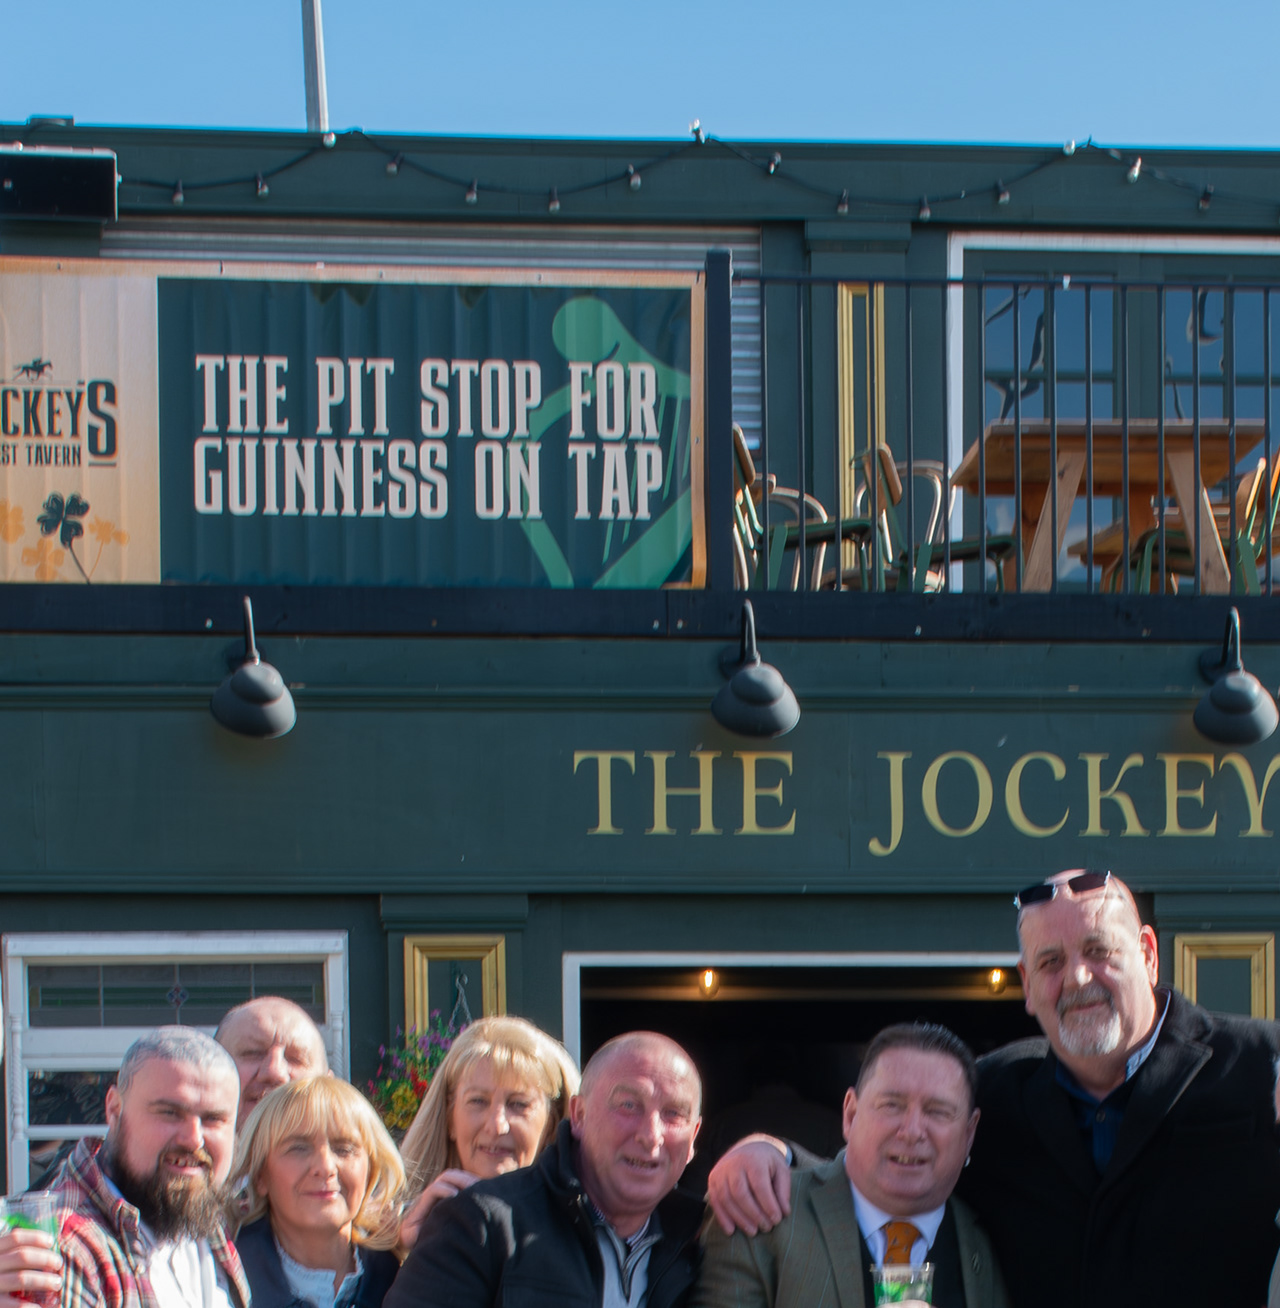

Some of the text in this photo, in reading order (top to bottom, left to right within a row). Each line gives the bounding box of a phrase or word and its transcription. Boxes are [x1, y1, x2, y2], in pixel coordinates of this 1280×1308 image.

[195, 354, 660, 440] THE PIT STOP FOR
[26, 443, 82, 468] TAVERN
[194, 437, 663, 521] GUINNESS ON TAP
[573, 750, 797, 836] THE
